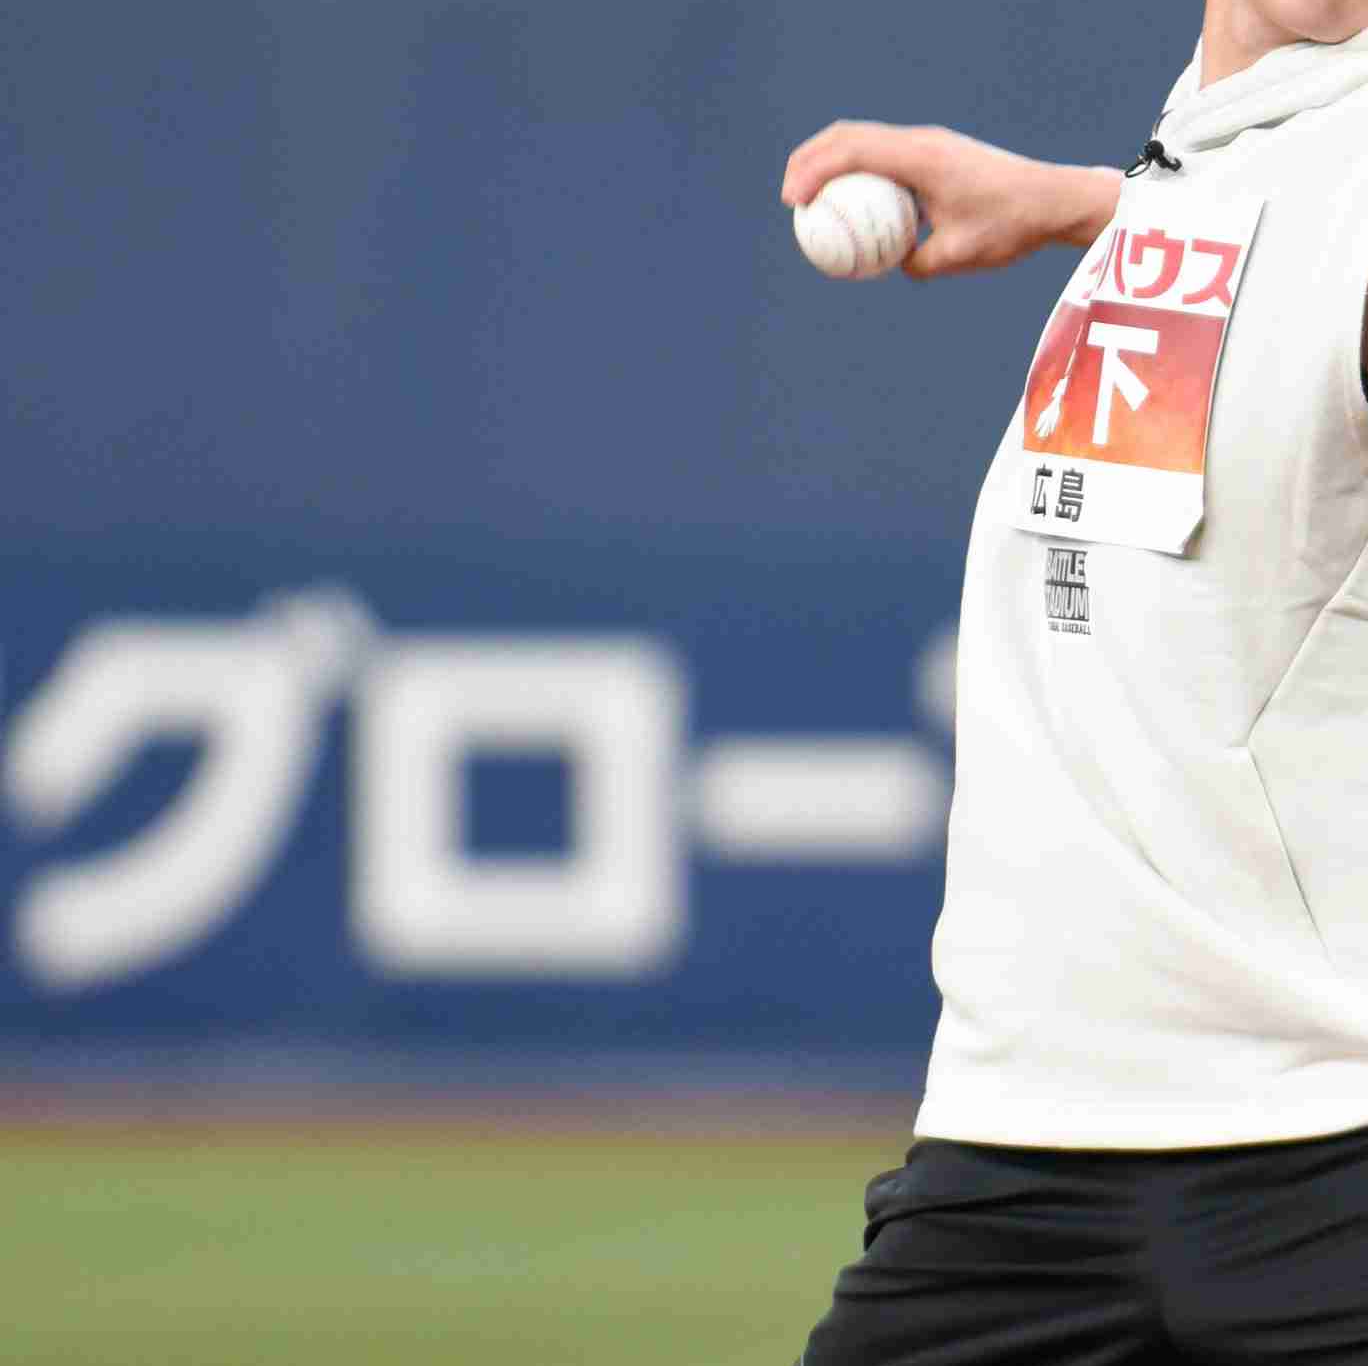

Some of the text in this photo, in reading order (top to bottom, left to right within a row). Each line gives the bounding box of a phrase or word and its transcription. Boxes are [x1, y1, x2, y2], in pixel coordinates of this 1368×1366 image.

[1082, 227, 1242, 309] ハウス
[1034, 321, 1160, 448] 下
[1030, 463, 1085, 523] 広島
[4, 585, 957, 993] グロー
